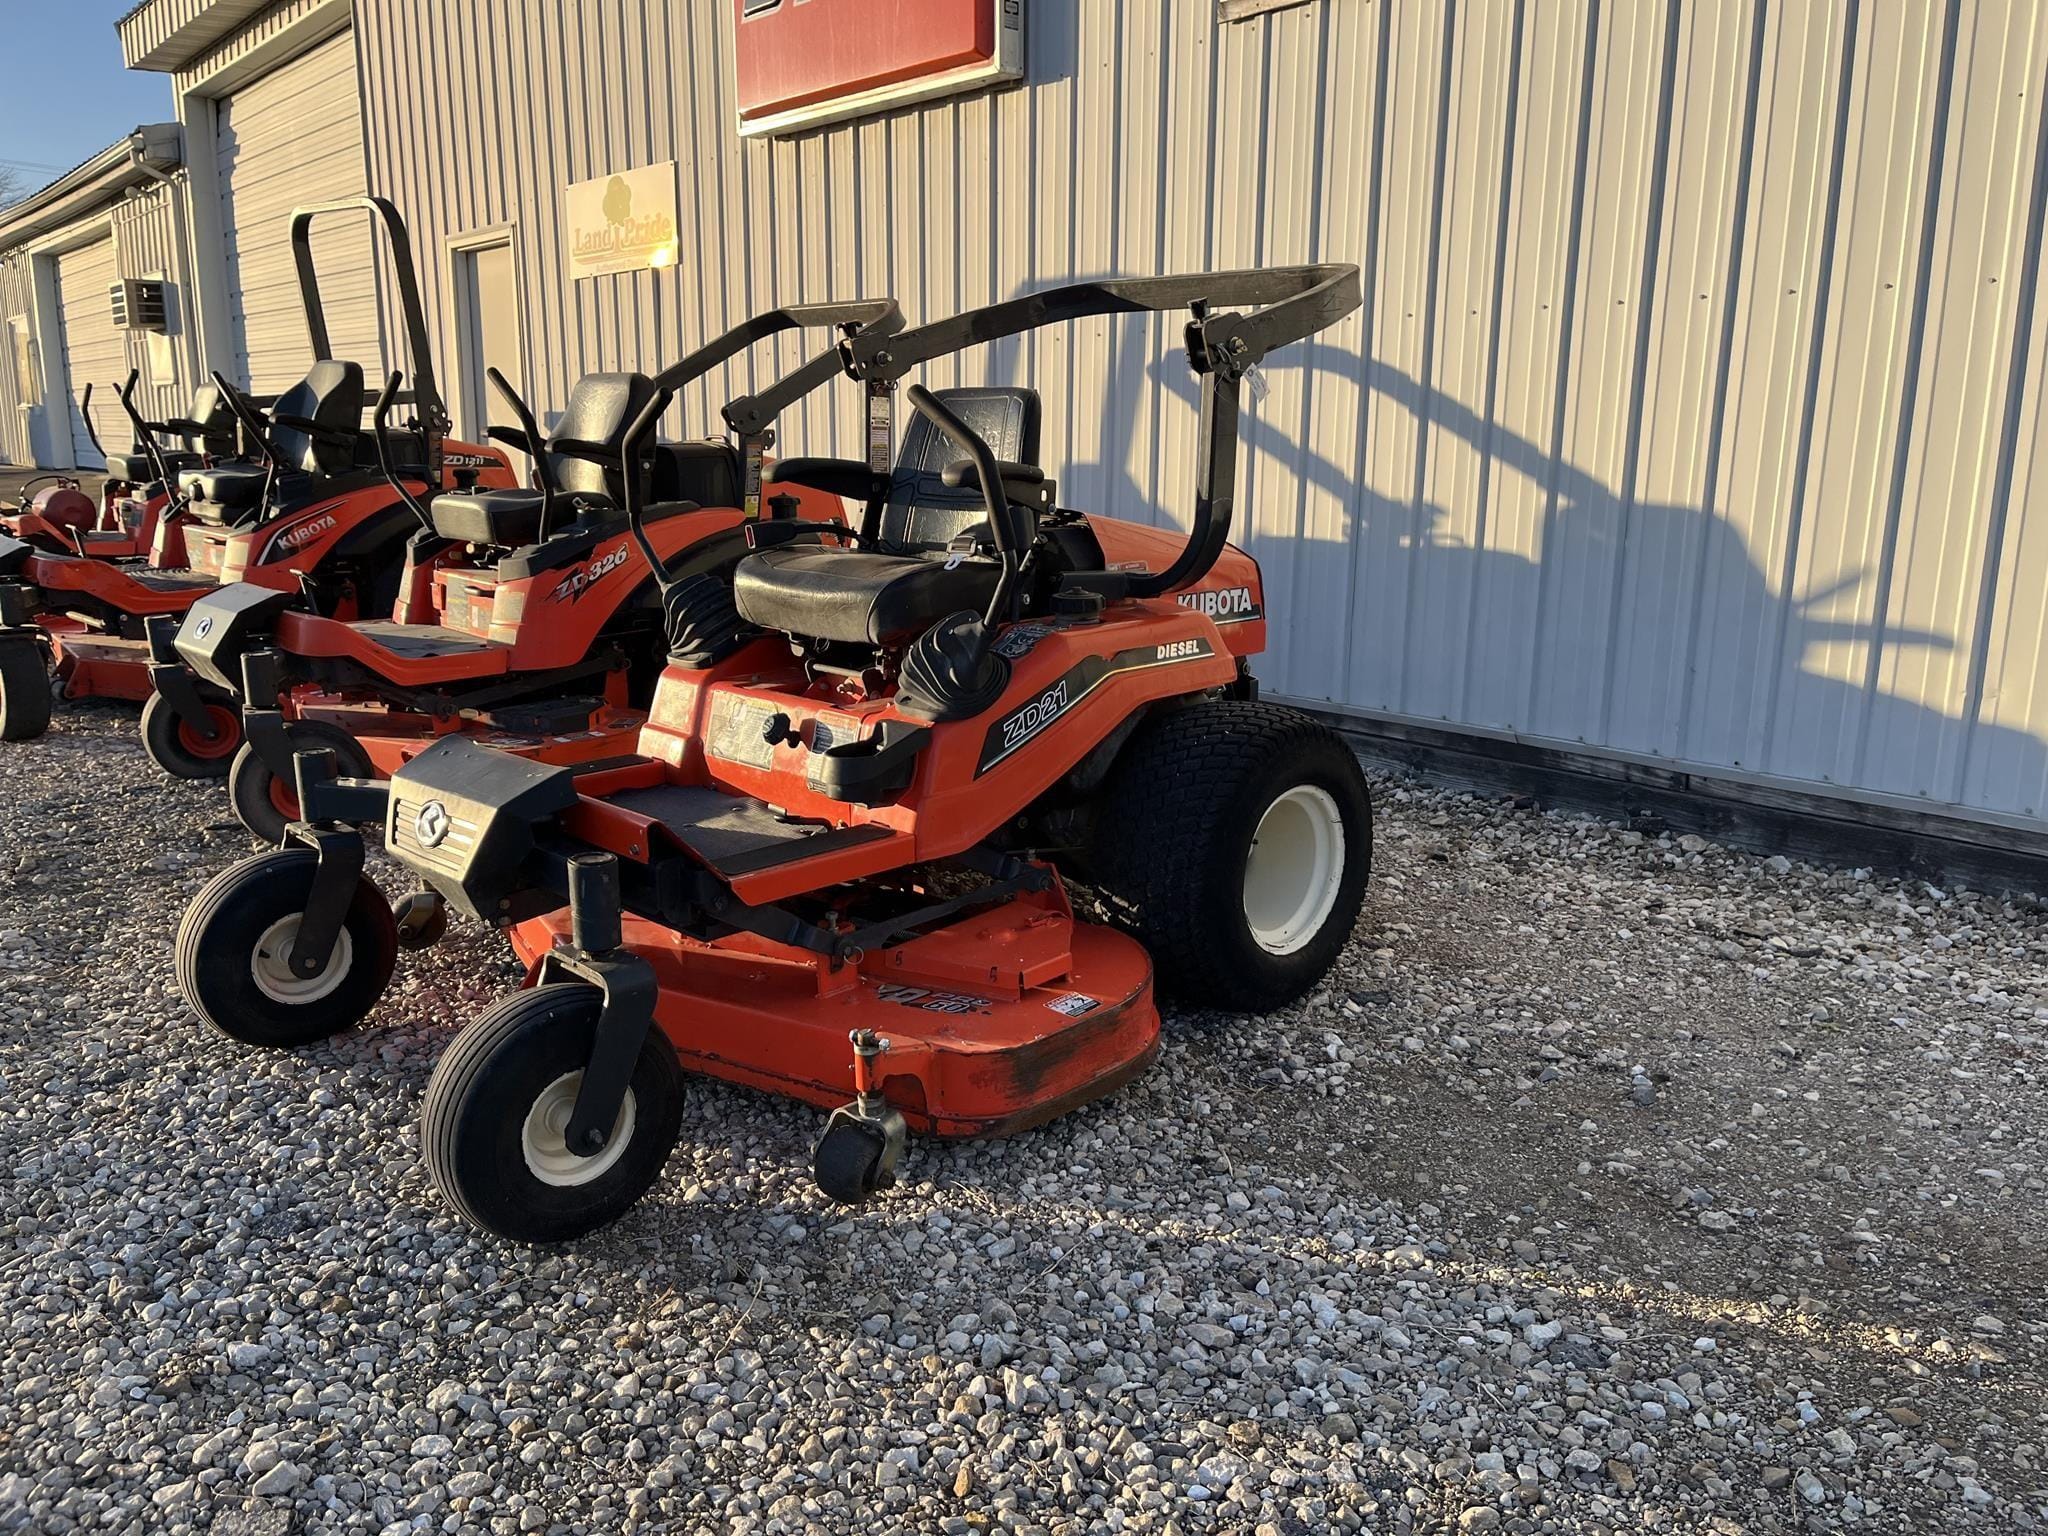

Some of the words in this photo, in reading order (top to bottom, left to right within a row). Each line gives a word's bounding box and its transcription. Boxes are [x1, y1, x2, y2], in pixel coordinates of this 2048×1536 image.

[573, 223, 614, 253] Land
[622, 212, 673, 245] Pride
[277, 515, 337, 550] KUBOTA
[1177, 587, 1252, 616] KUBOTA
[1156, 639, 1200, 660] DIESEL
[1003, 679, 1068, 749] ZD21
